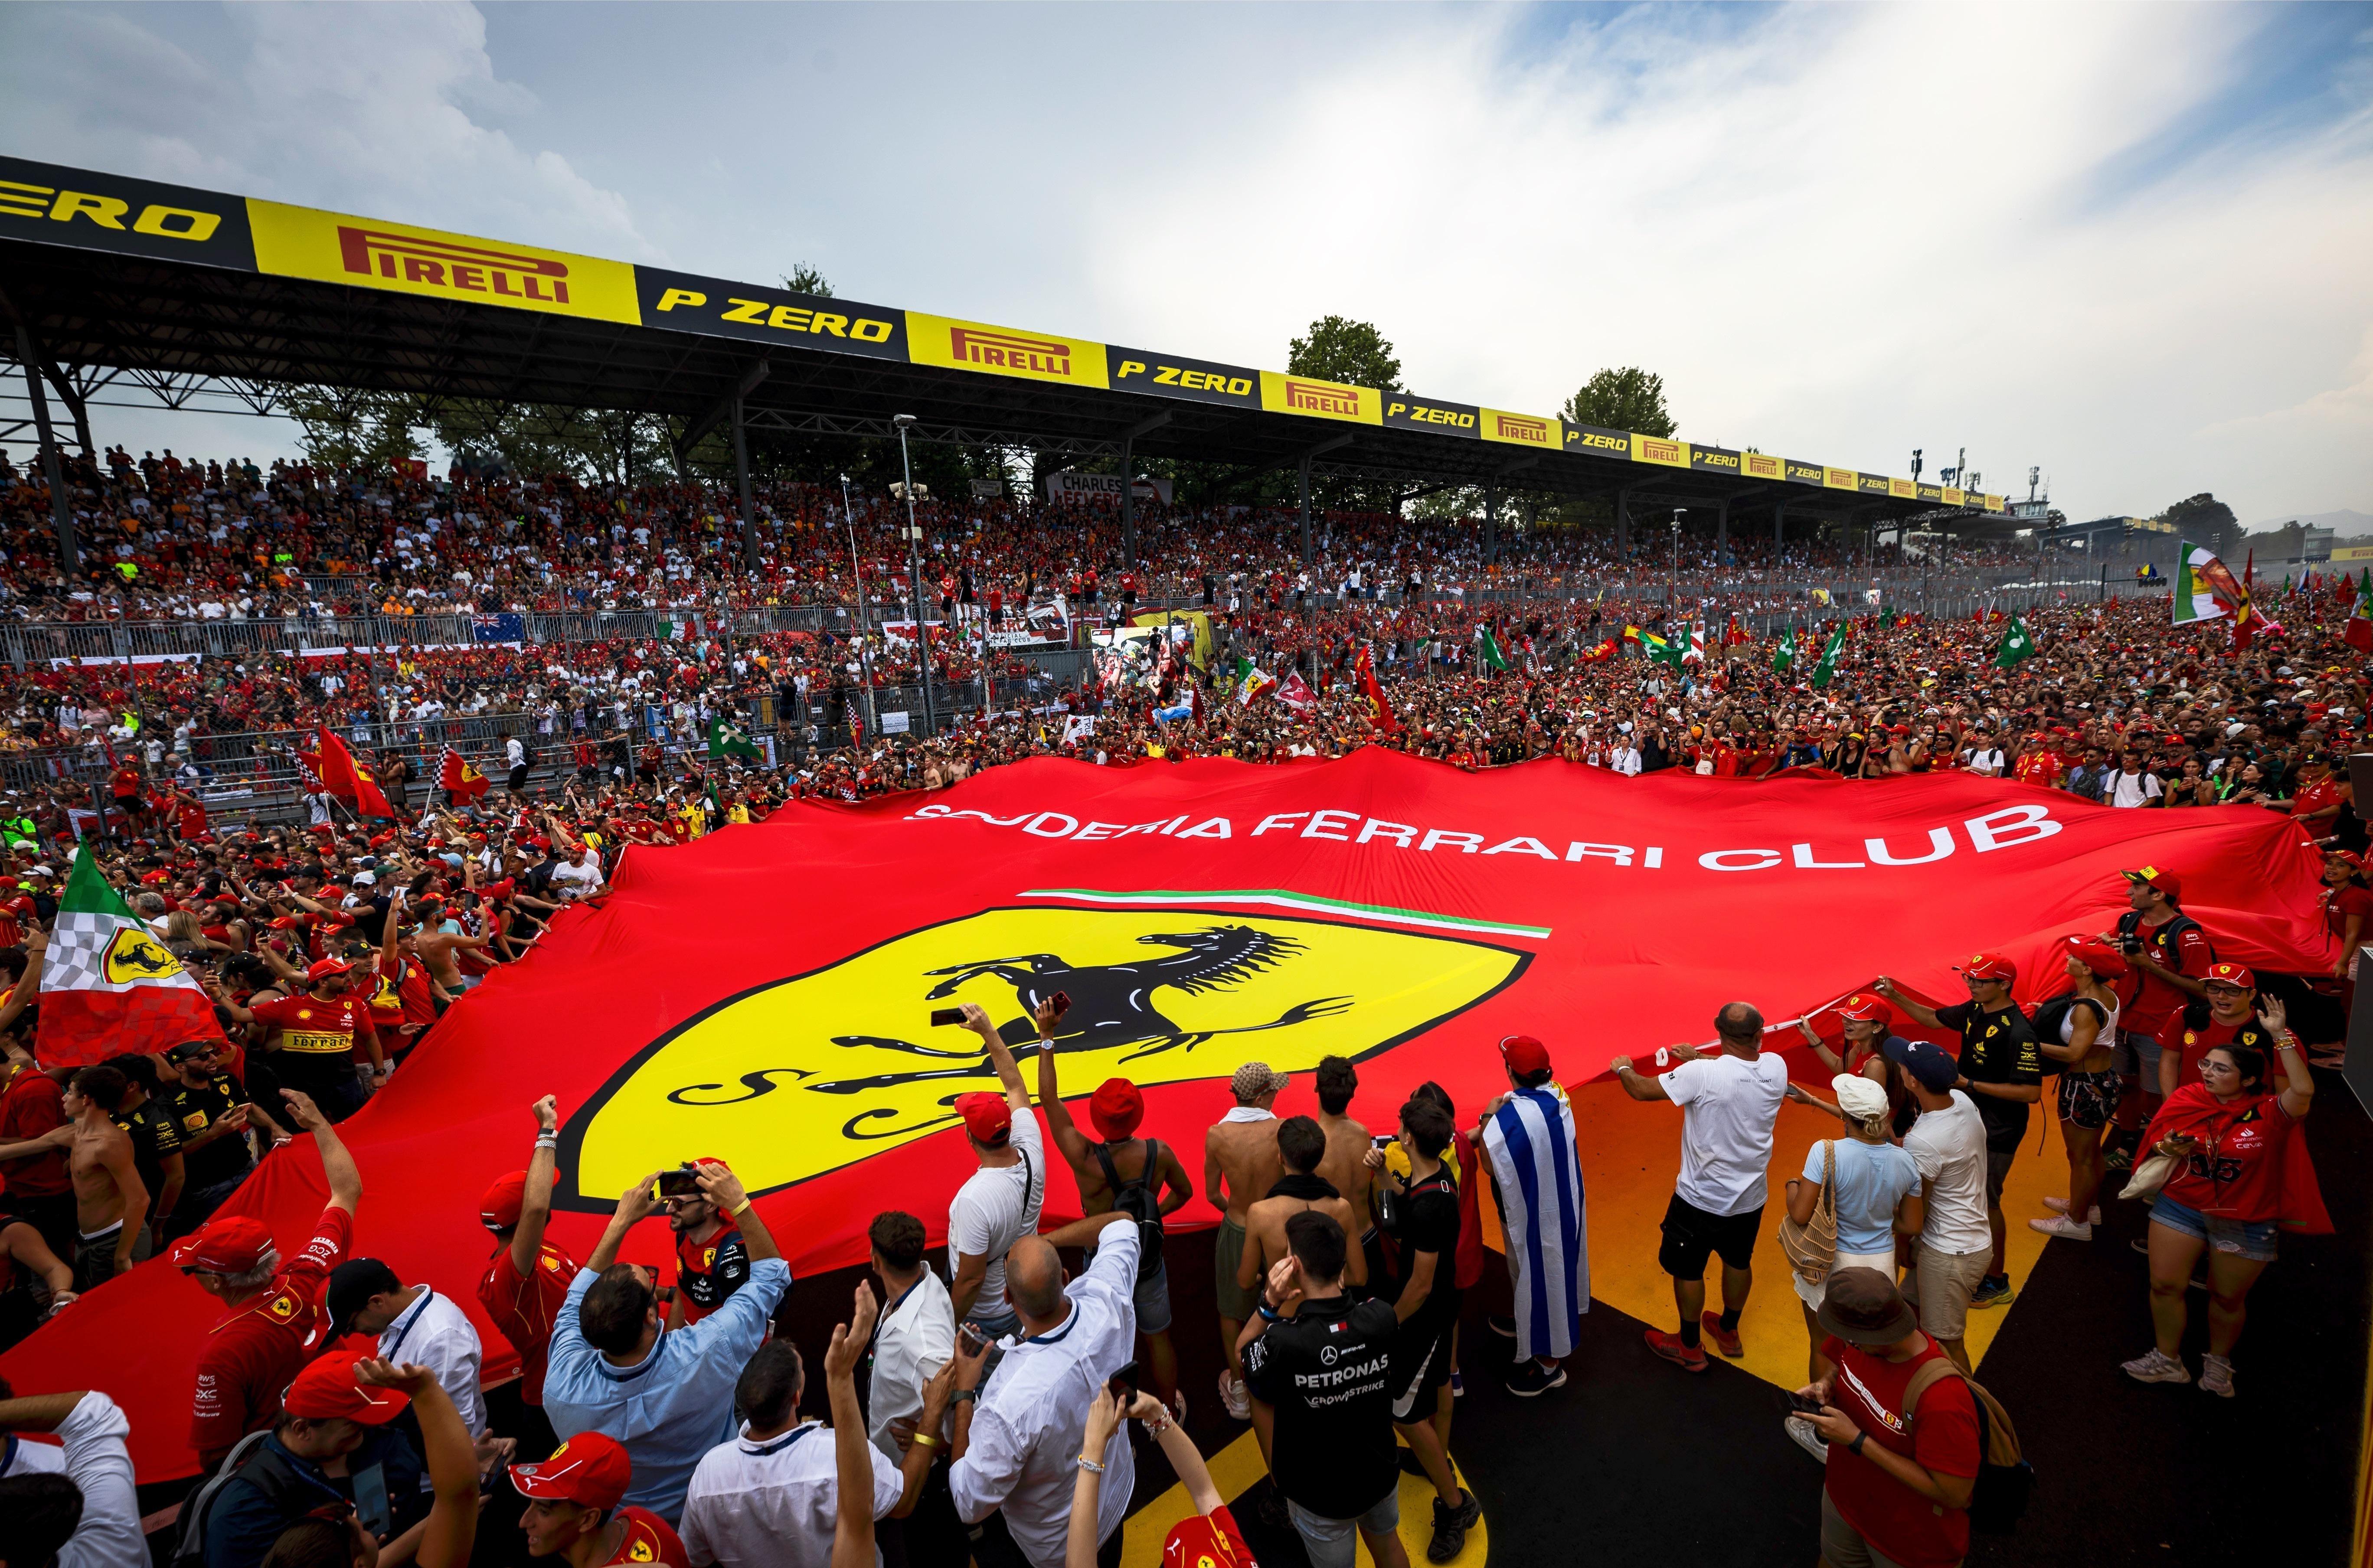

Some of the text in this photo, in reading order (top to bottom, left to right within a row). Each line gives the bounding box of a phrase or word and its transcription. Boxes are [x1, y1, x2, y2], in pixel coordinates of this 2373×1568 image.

[338, 226, 569, 303] PIRELLI
[657, 288, 892, 342] P ZERO
[951, 327, 1070, 375] PIRELLI
[1118, 361, 1252, 395] P ZERO
[1286, 381, 1358, 415] PIRELLI
[1388, 403, 1474, 427] P ZERO
[1497, 416, 1546, 442] PIRELLI
[1567, 431, 1628, 451] P ZERO
[1644, 441, 1679, 462] PIRELLI
[1693, 452, 1738, 467] P ZERO
[1750, 457, 1776, 475] PIRELLI
[1797, 467, 1821, 479] ZERO
[1063, 476, 1122, 493] CHARLES
[1830, 471, 1851, 486] PIRELLI
[1866, 479, 1887, 489] ZERO
[1895, 481, 1911, 495] PIRELLI
[1923, 488, 1941, 497] ZERO
[1970, 496, 1984, 504] ZERO
[1251, 810, 1663, 868] FERRARI
[1699, 805, 2062, 871] CLUB
[293, 1034, 348, 1047] Ferrari
[308, 1245, 331, 1258] ZCG
[1295, 1354, 1388, 1388] PETRONAS
